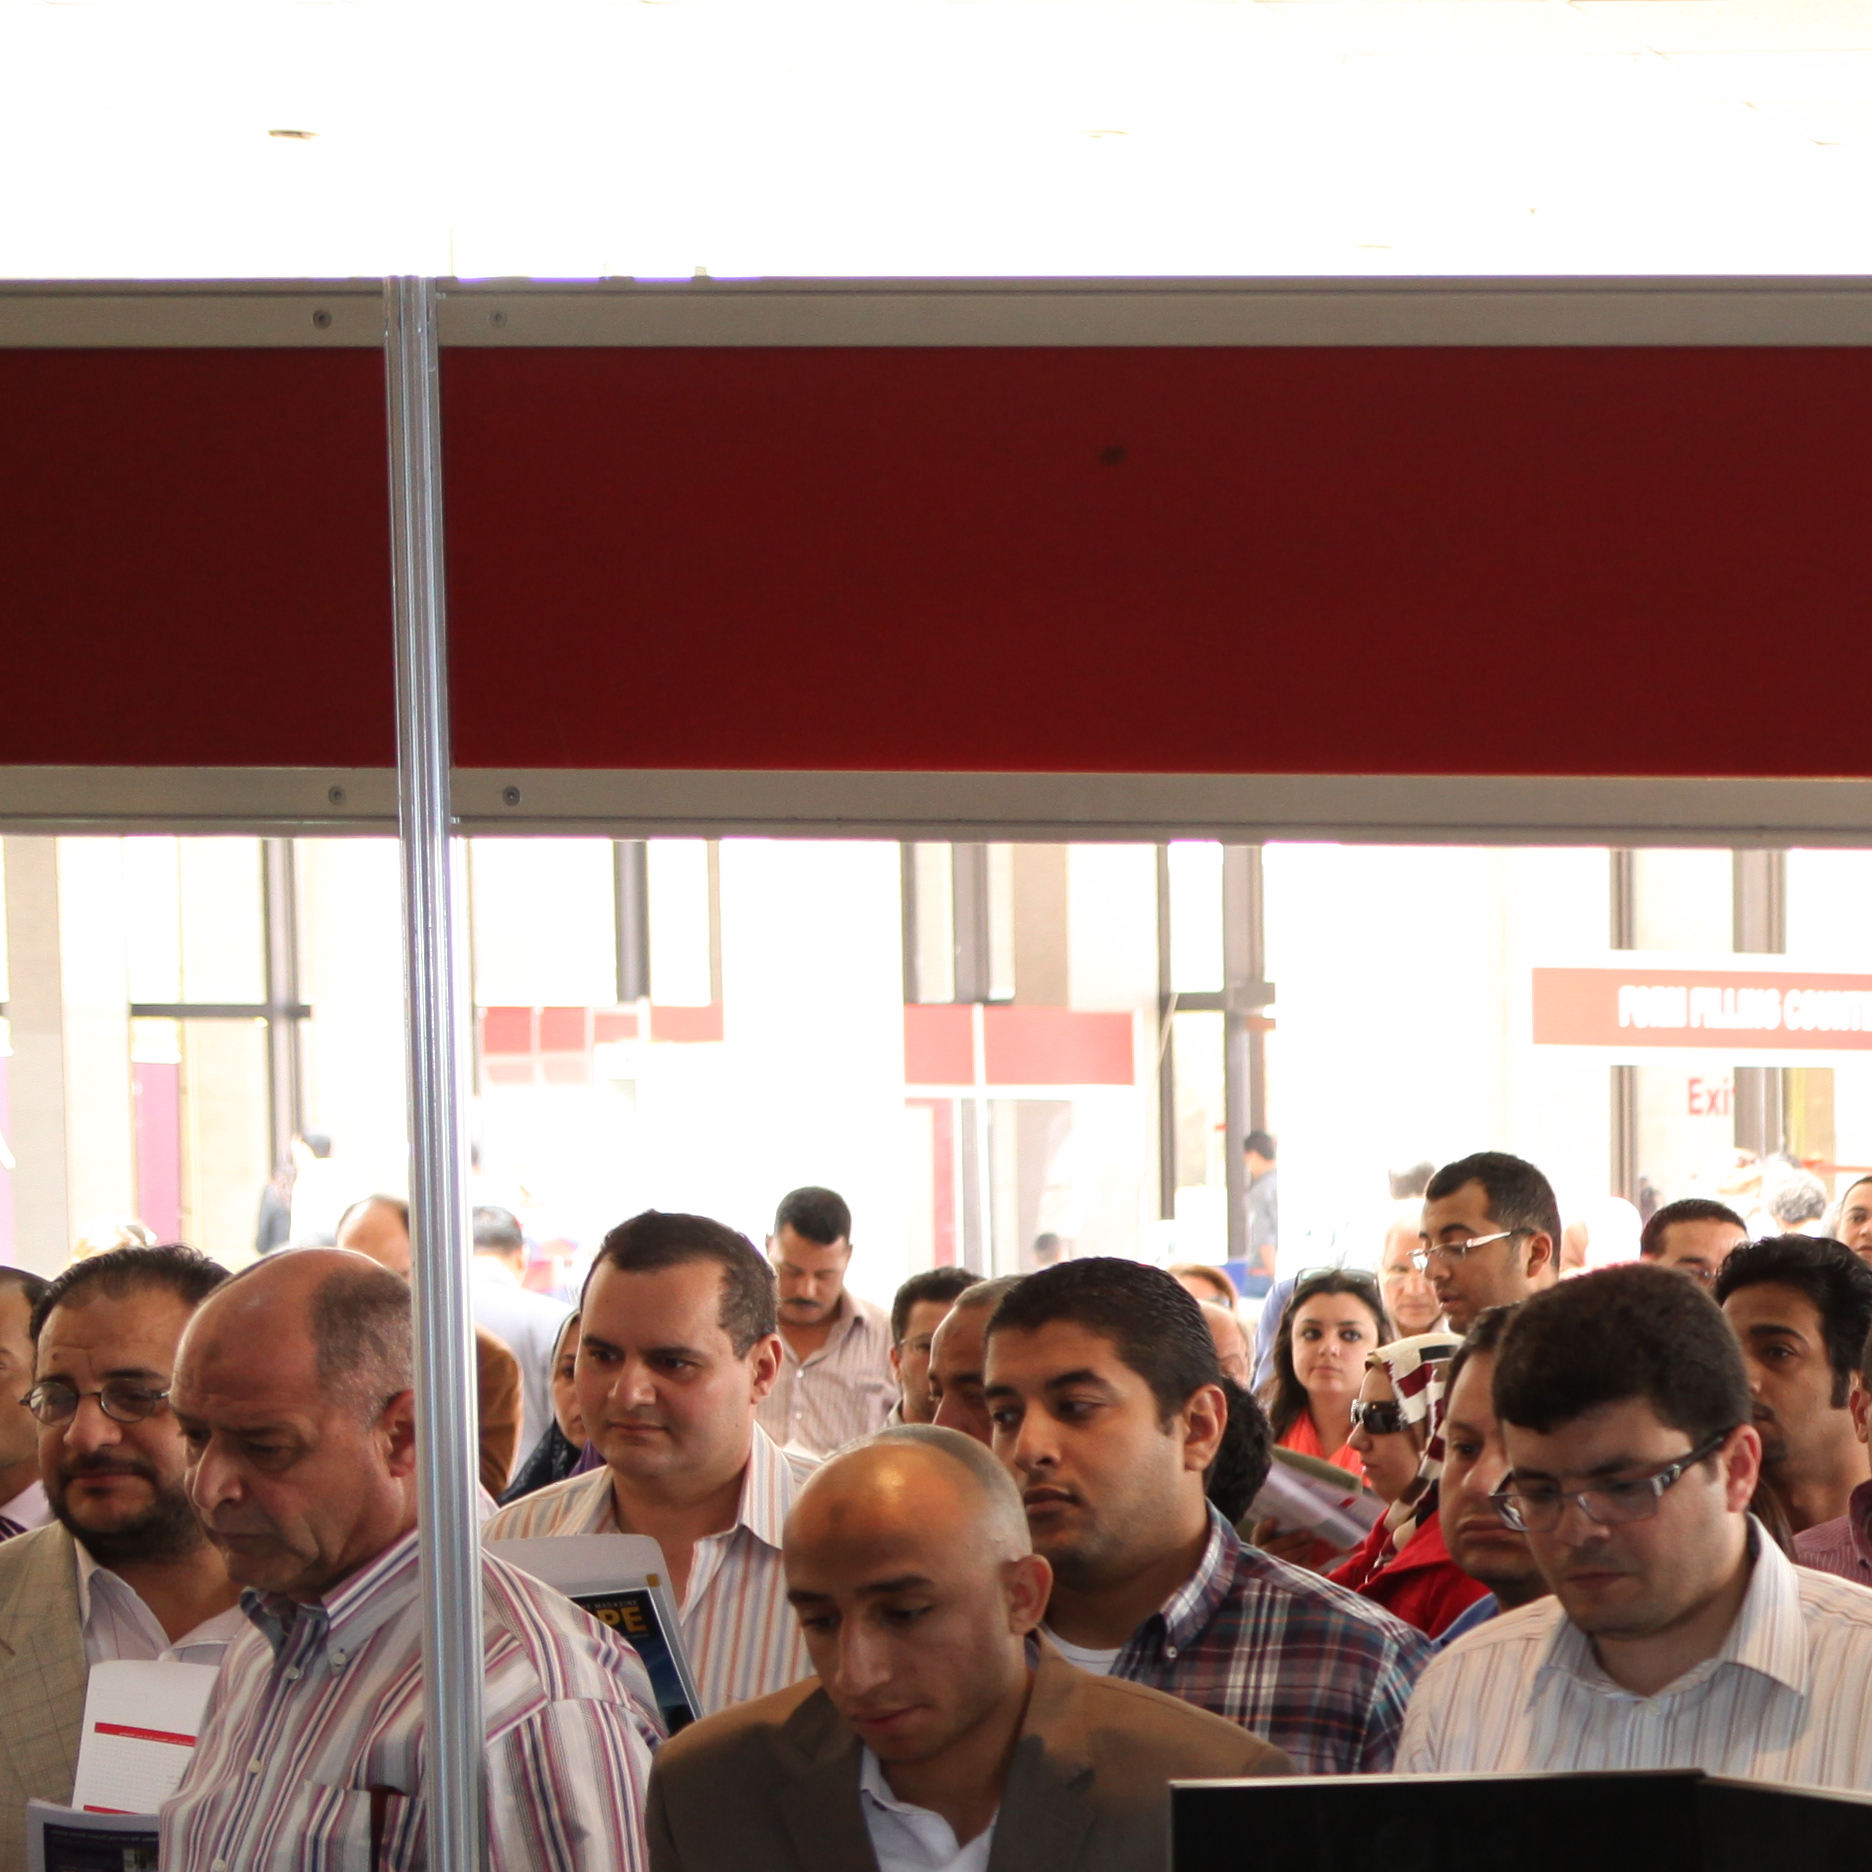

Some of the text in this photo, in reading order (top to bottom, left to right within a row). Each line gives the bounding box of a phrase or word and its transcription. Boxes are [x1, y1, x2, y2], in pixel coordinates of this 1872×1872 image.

[1618, 985, 1686, 1028] FORM
[1689, 987, 1782, 1030] FILLING
[1688, 1077, 1737, 1116] Exi
